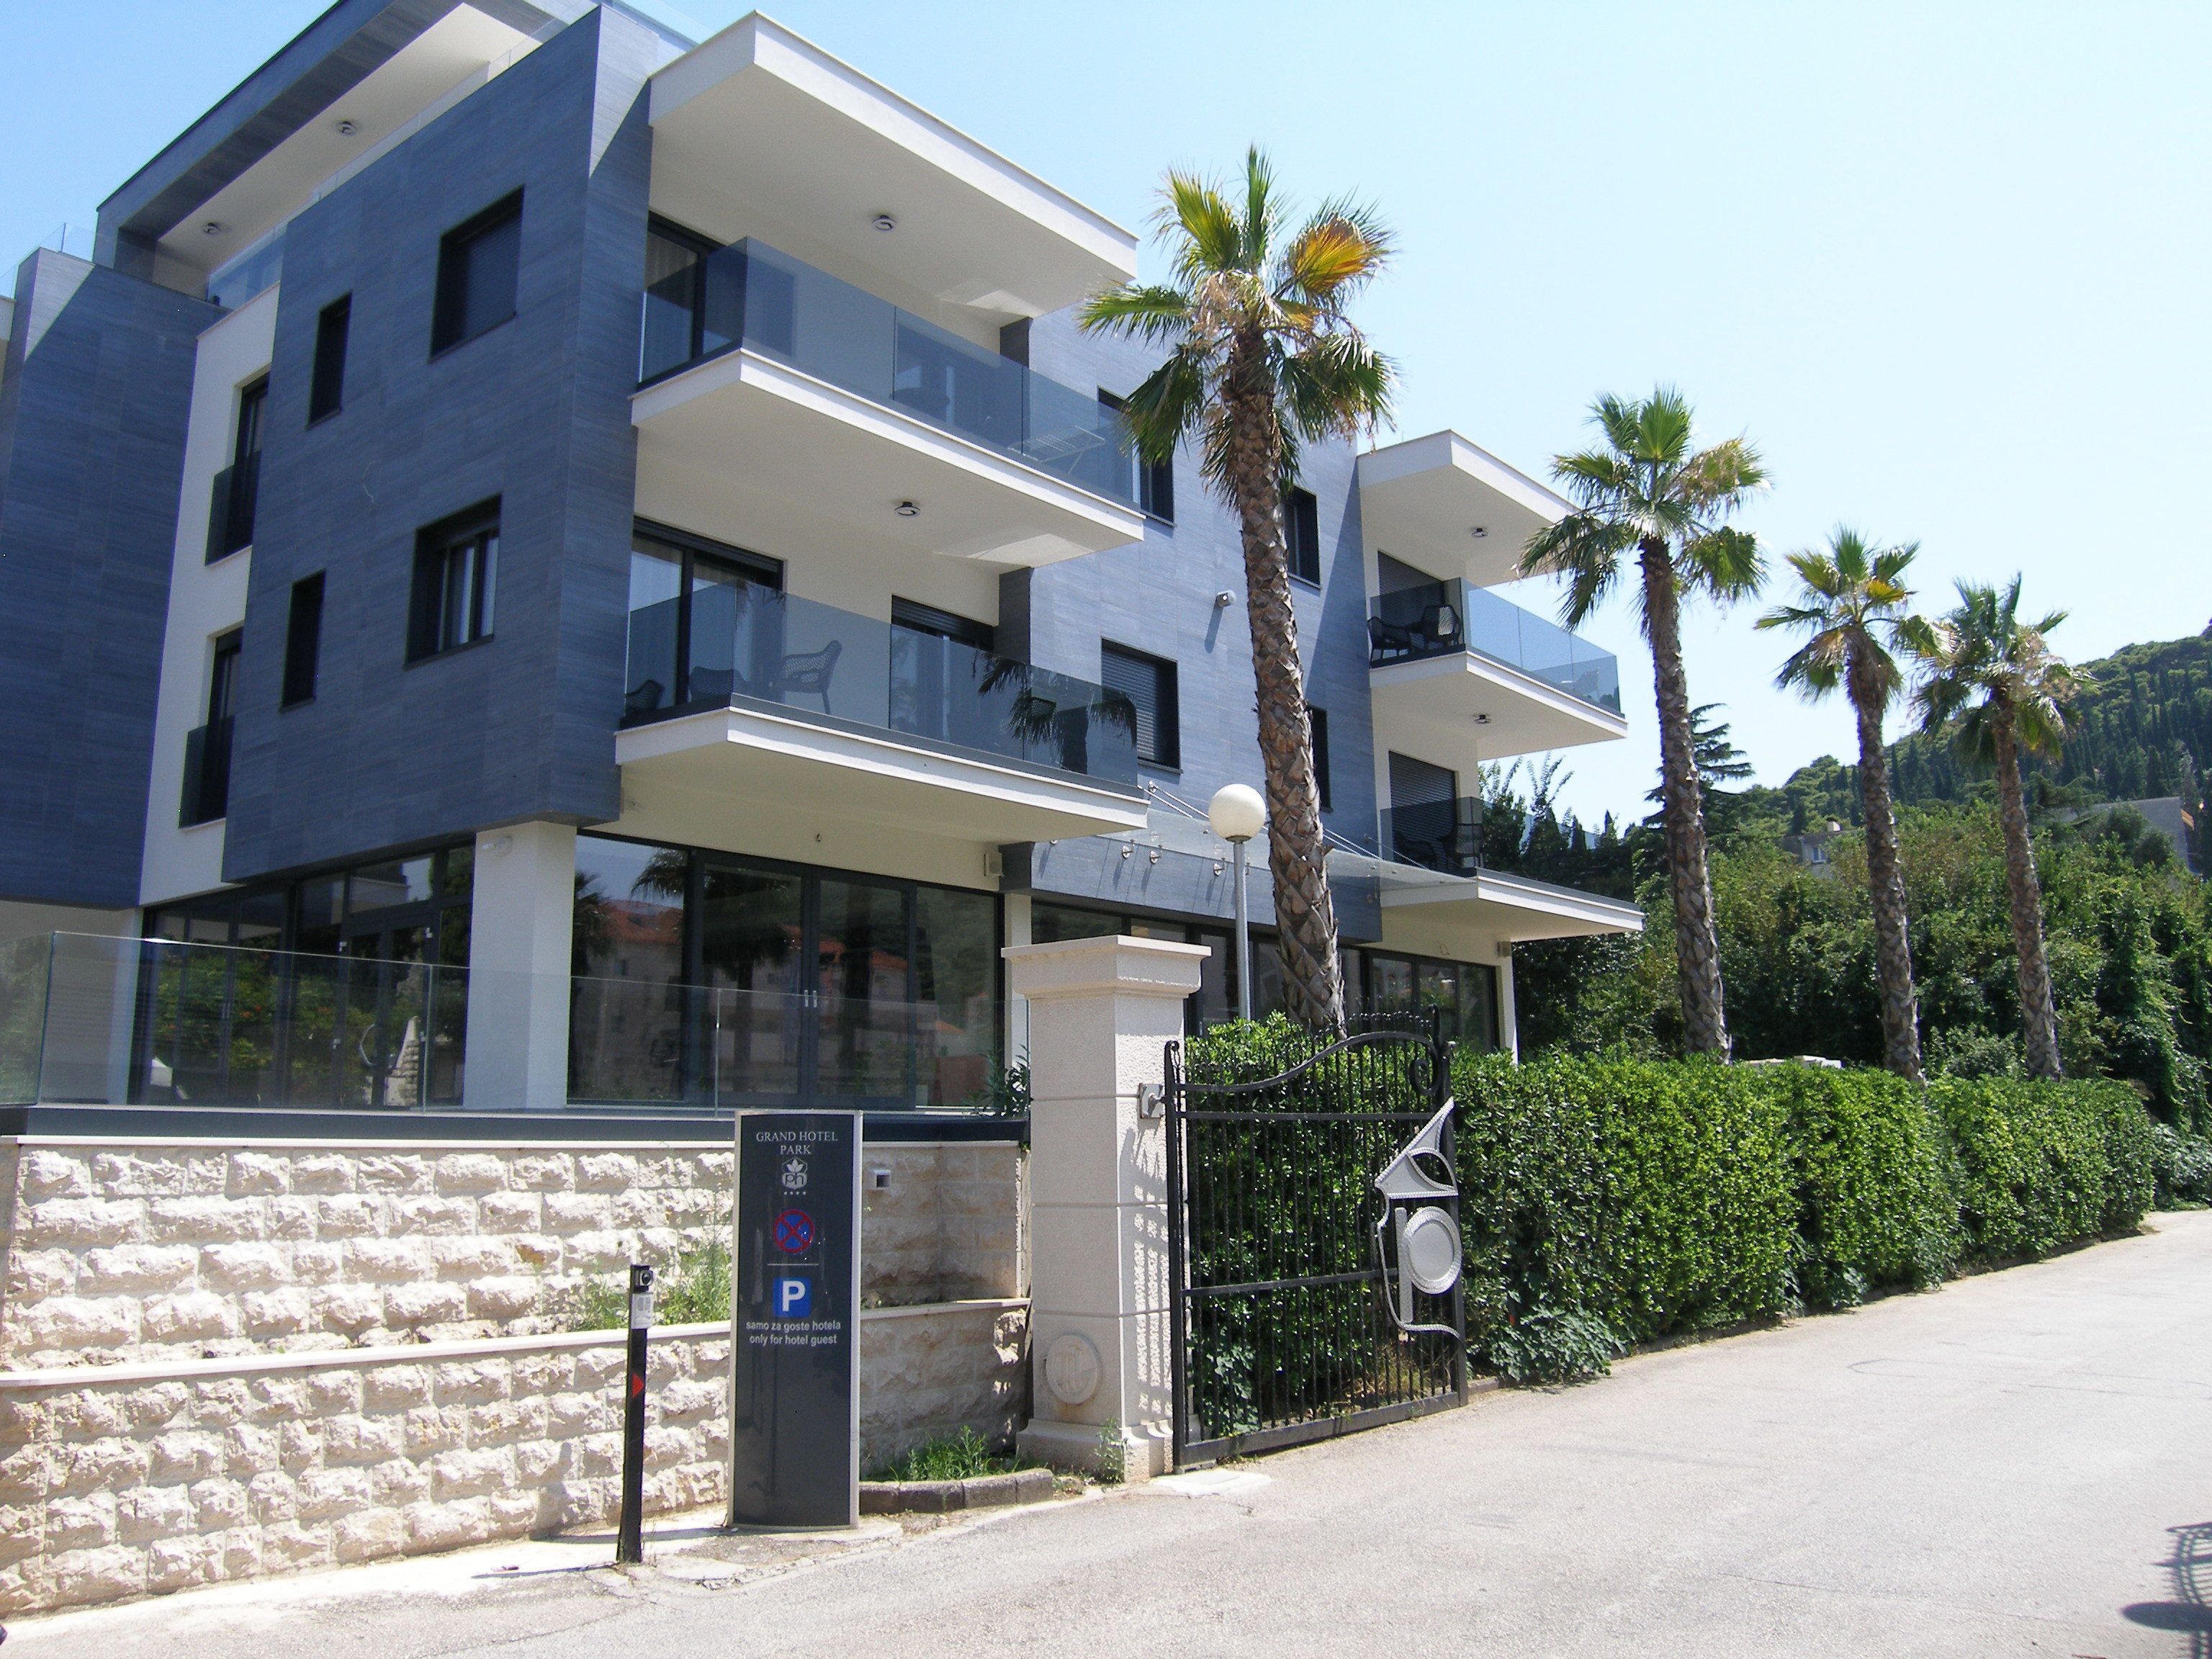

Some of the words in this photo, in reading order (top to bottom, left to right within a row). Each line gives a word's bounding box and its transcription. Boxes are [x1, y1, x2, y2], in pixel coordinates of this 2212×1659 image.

[756, 1131, 796, 1141] GRAND
[799, 1131, 838, 1141] HOTEL
[780, 1145, 811, 1154] PARK
[782, 1280, 806, 1312] P
[746, 1321, 770, 1331] samo
[771, 1322, 781, 1331] za
[783, 1321, 810, 1334] goste
[812, 1320, 841, 1331] hotela
[749, 1334, 768, 1346] only
[770, 1334, 783, 1344] for
[785, 1334, 808, 1344] hotel
[811, 1334, 837, 1346] guest
